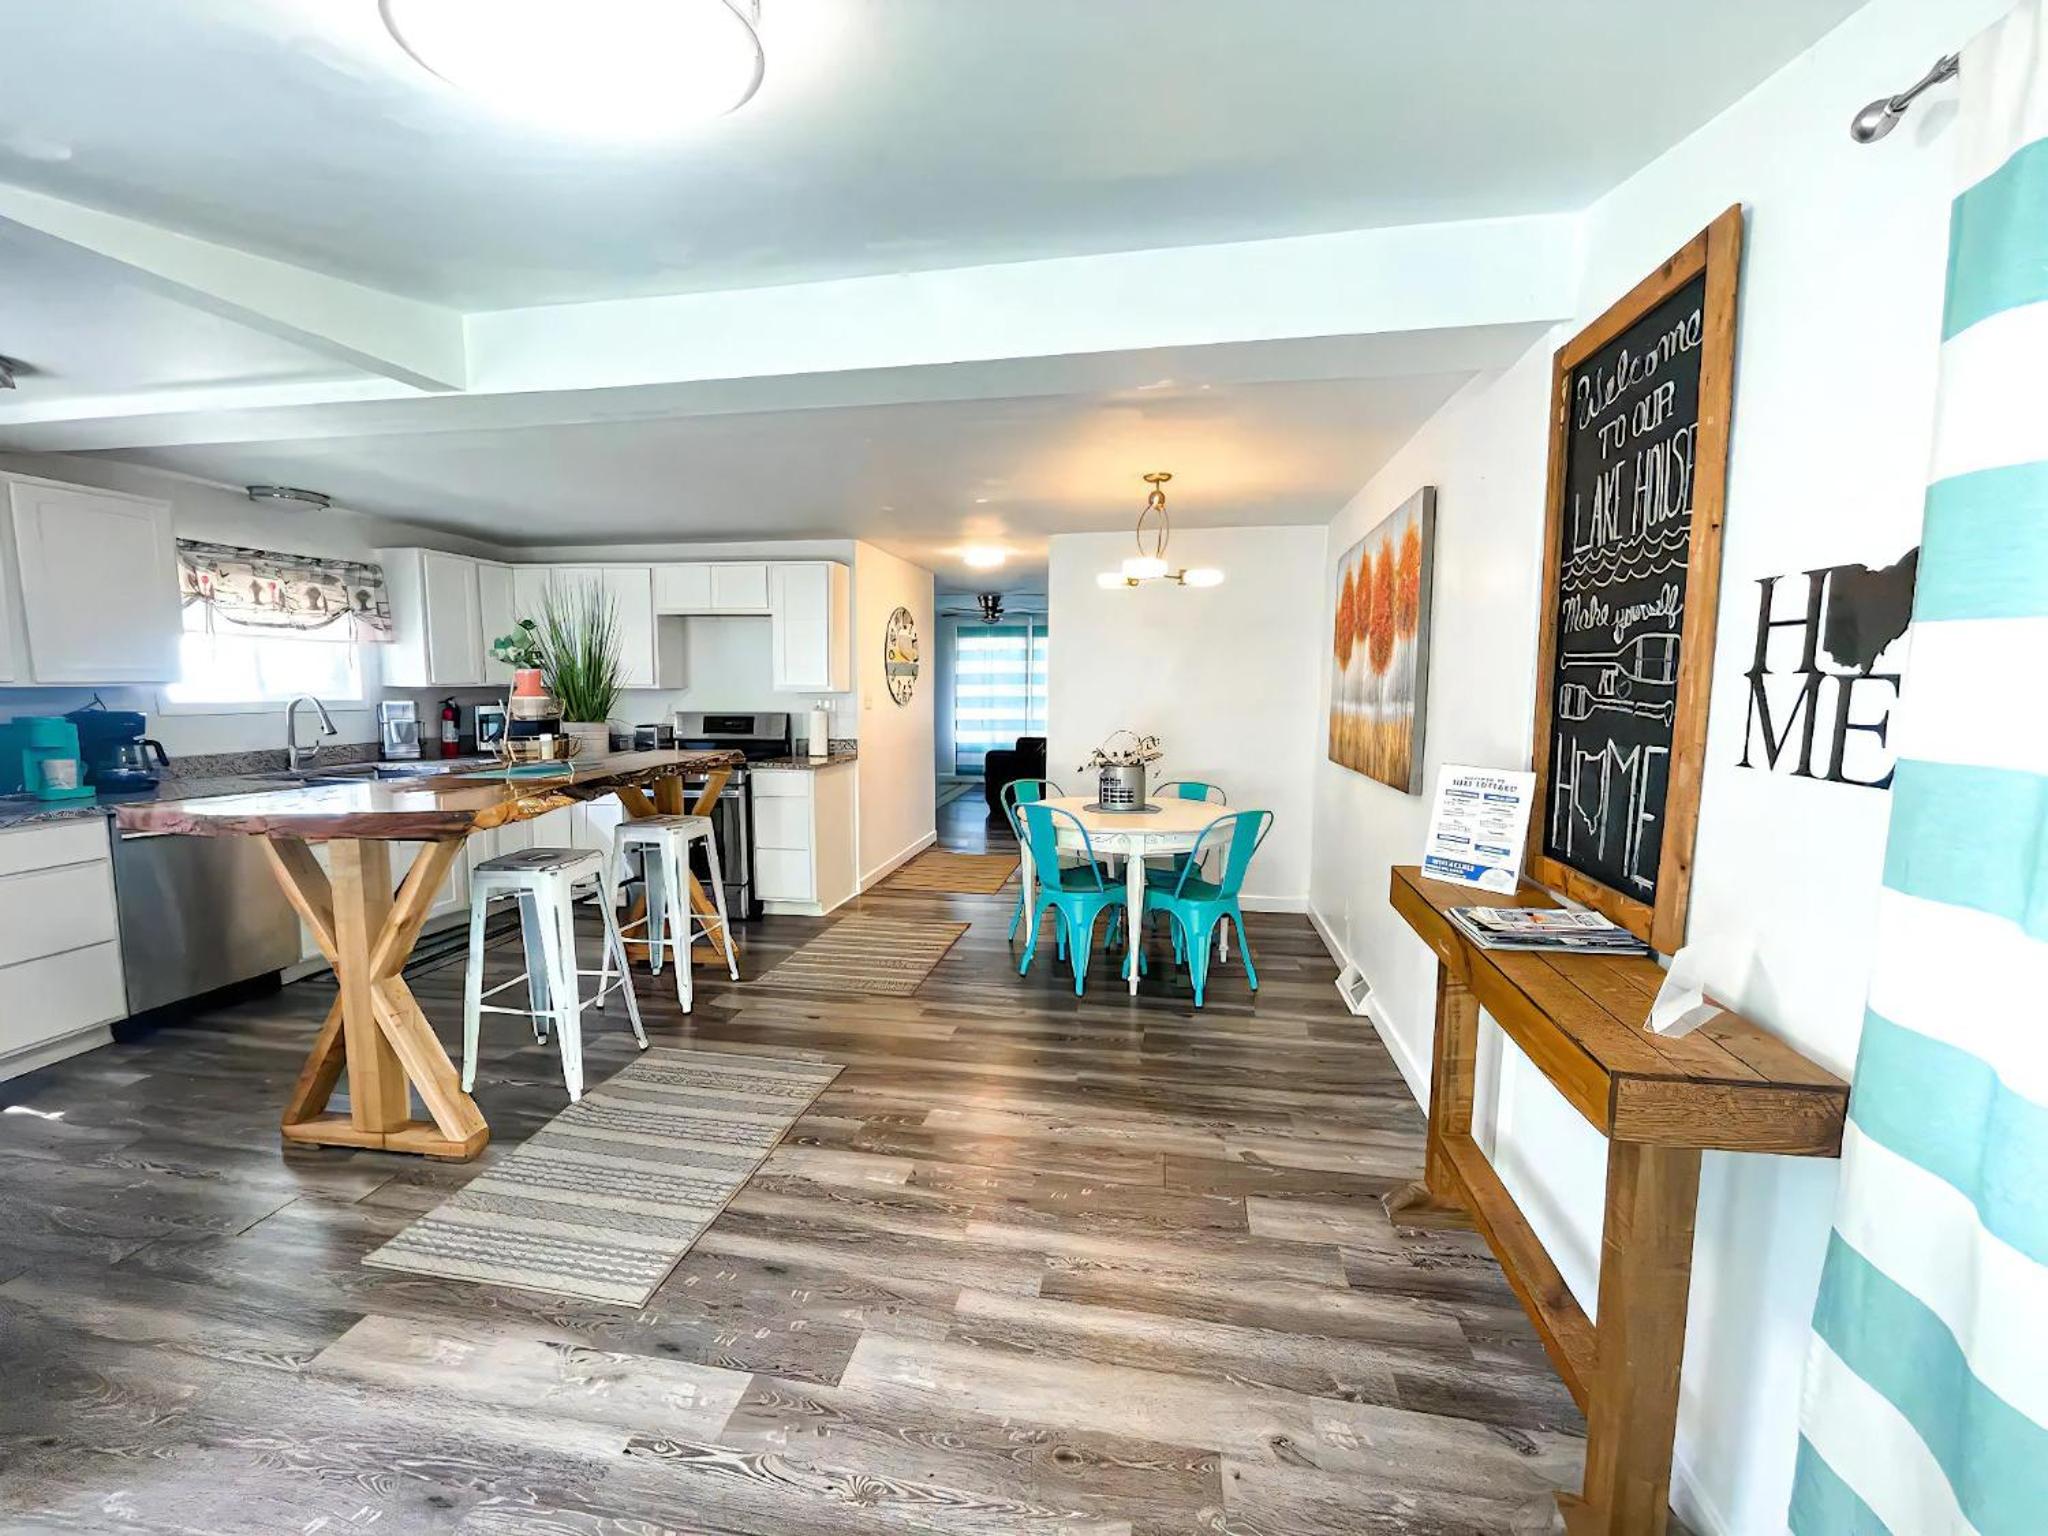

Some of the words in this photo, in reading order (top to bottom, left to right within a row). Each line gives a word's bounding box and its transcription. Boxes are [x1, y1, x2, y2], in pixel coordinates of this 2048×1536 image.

[1577, 308, 1704, 430] Welcome
[1599, 414, 1626, 459] TO
[1633, 380, 1675, 437] OUR
[1573, 460, 1625, 554] LAKE
[1632, 422, 1698, 535] HOUSE
[1563, 594, 1609, 634] Make
[1611, 583, 1684, 644] yourself
[1552, 733, 1668, 891] HME
